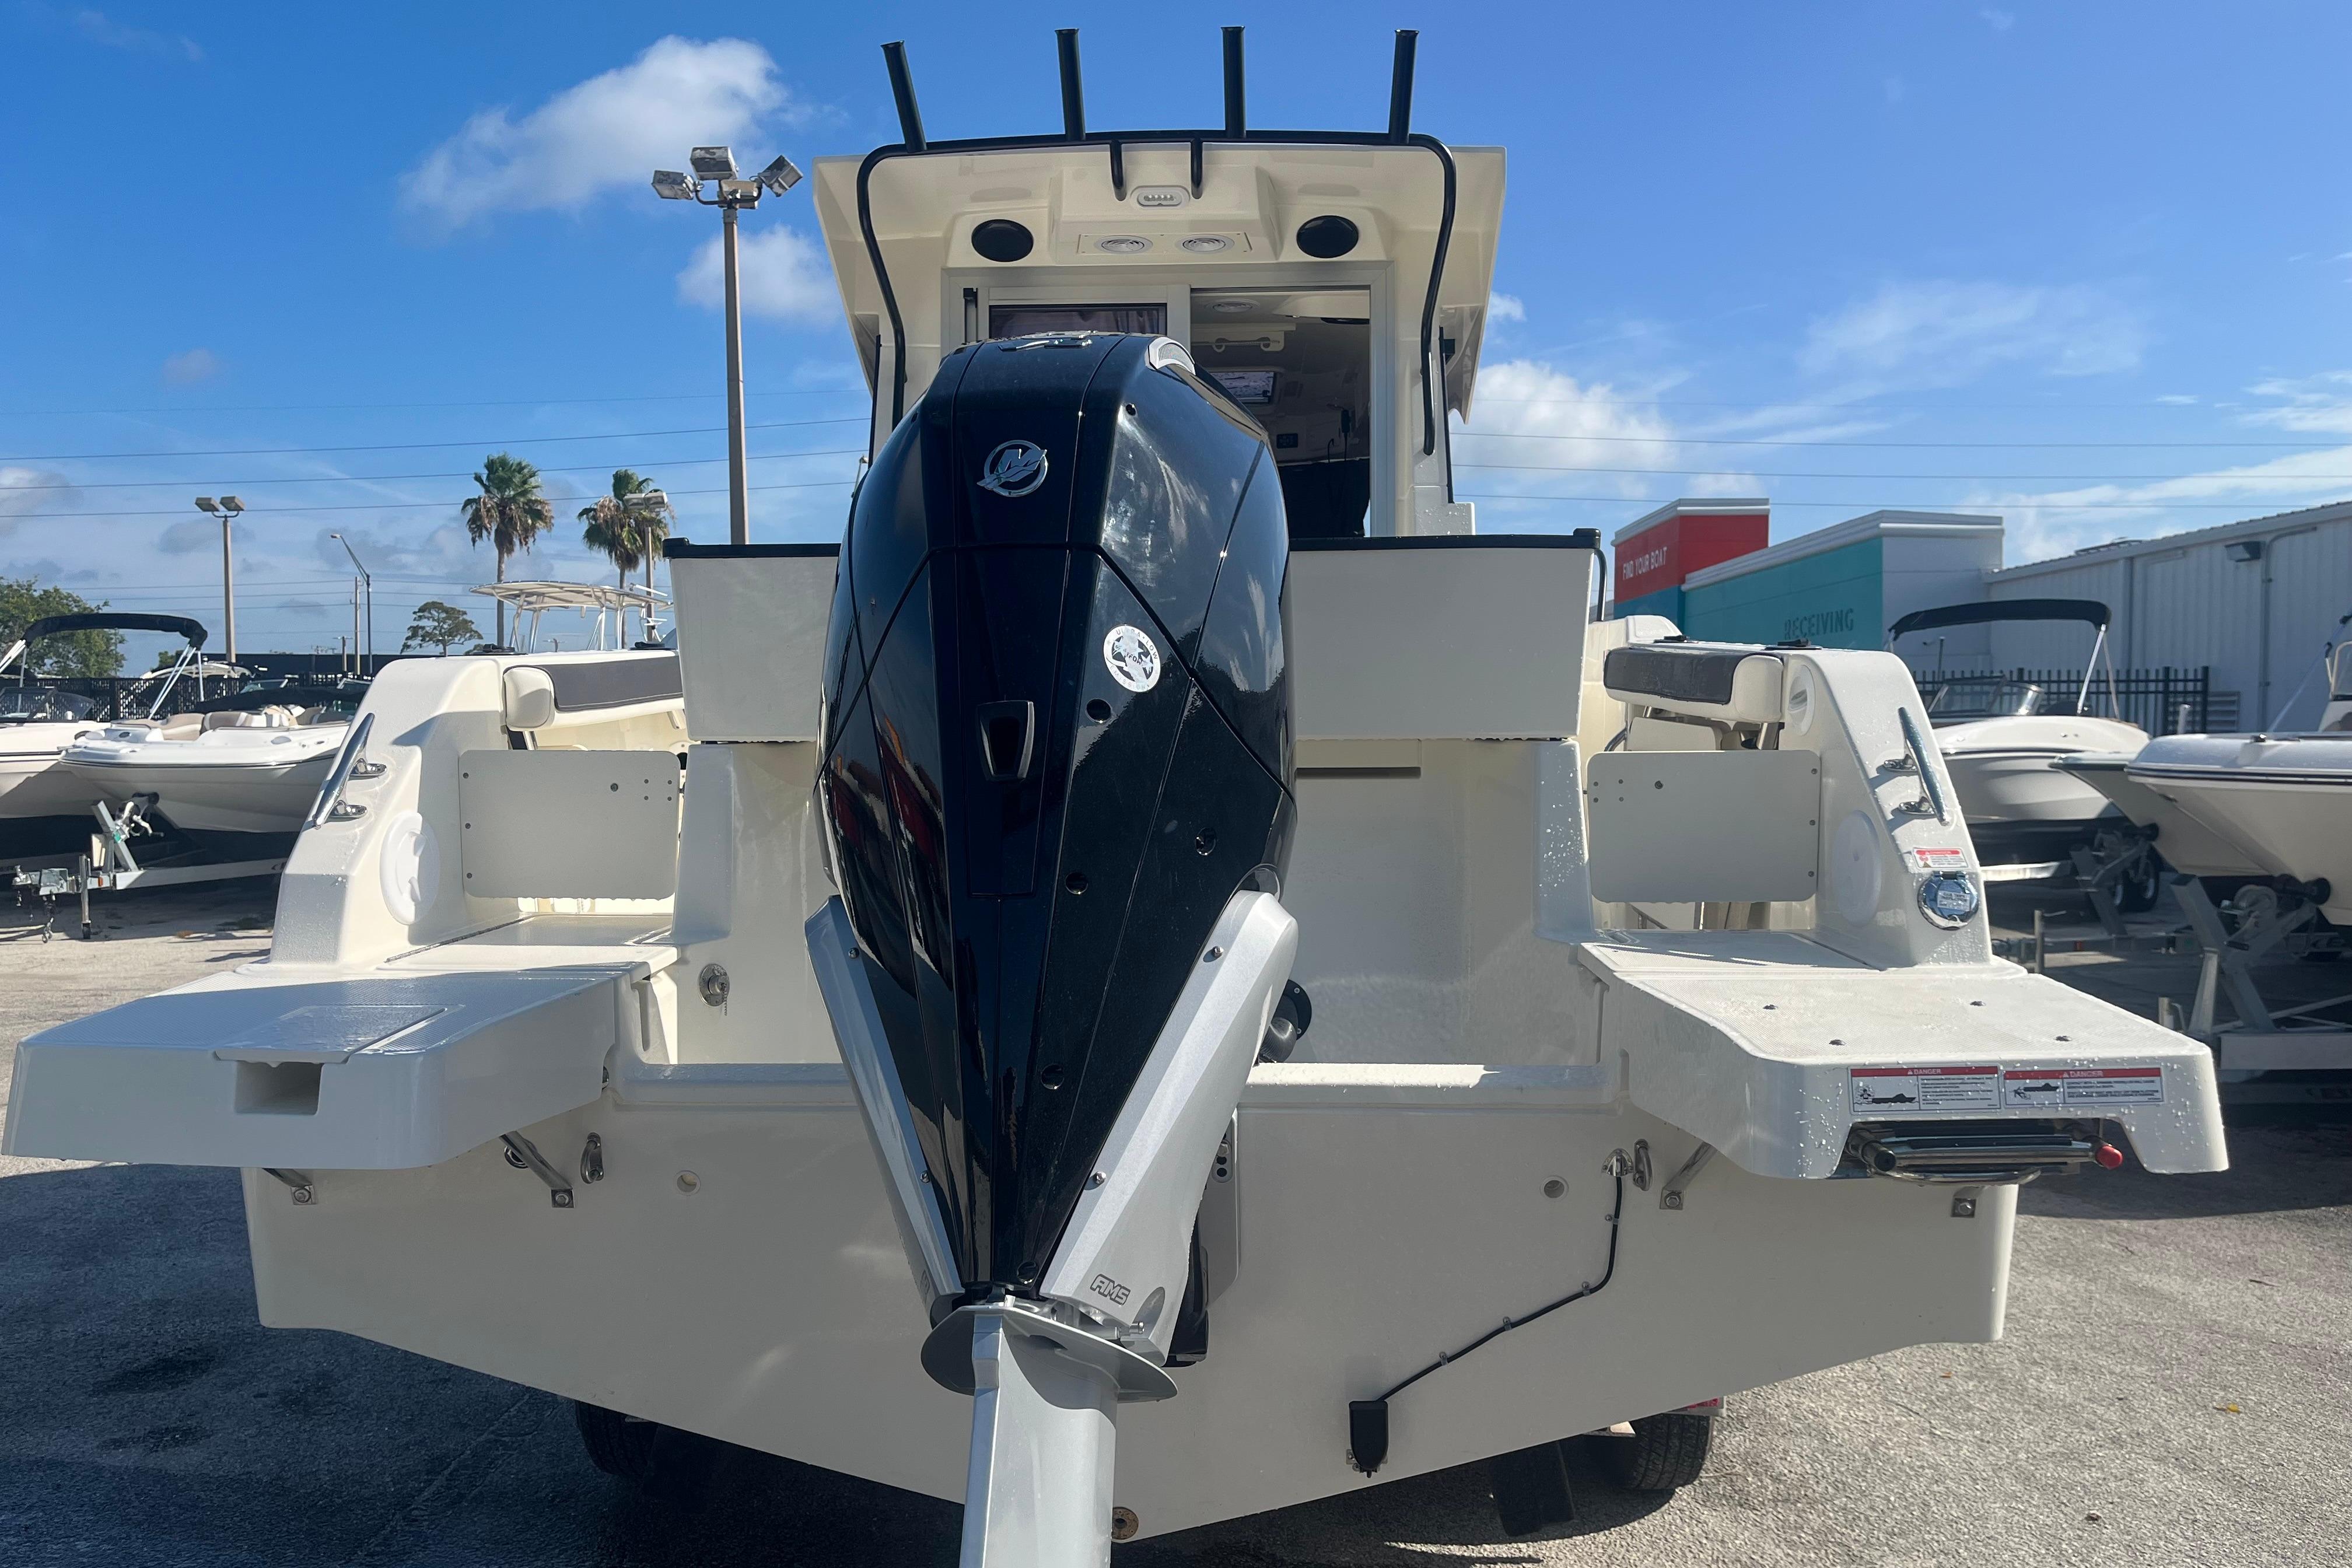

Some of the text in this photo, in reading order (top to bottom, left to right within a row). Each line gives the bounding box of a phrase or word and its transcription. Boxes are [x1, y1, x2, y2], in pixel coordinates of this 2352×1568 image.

[1622, 547, 1667, 580] FIND YOUR BOAT
[1784, 608, 1854, 640] RECEIVING
[1115, 628, 1158, 659] ULRA LOW
[1088, 1273, 1130, 1304] AMS
